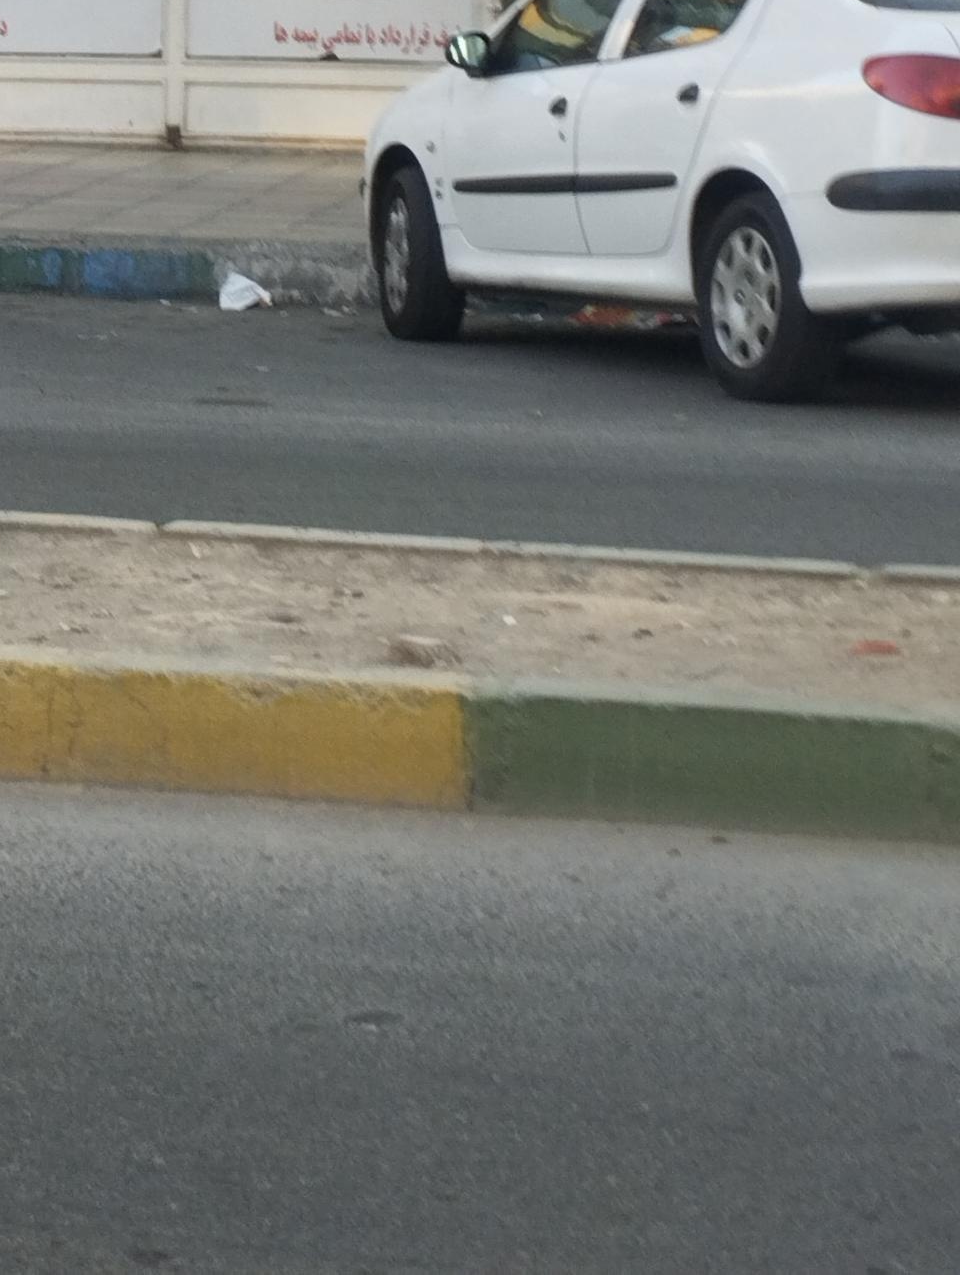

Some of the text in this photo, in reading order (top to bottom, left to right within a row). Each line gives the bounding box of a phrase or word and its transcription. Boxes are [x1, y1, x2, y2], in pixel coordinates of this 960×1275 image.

[273, 21, 289, 42] ها
[292, 26, 320, 49] بیمه
[321, 23, 363, 51] تمامی
[379, 22, 431, 54] قرارداد
